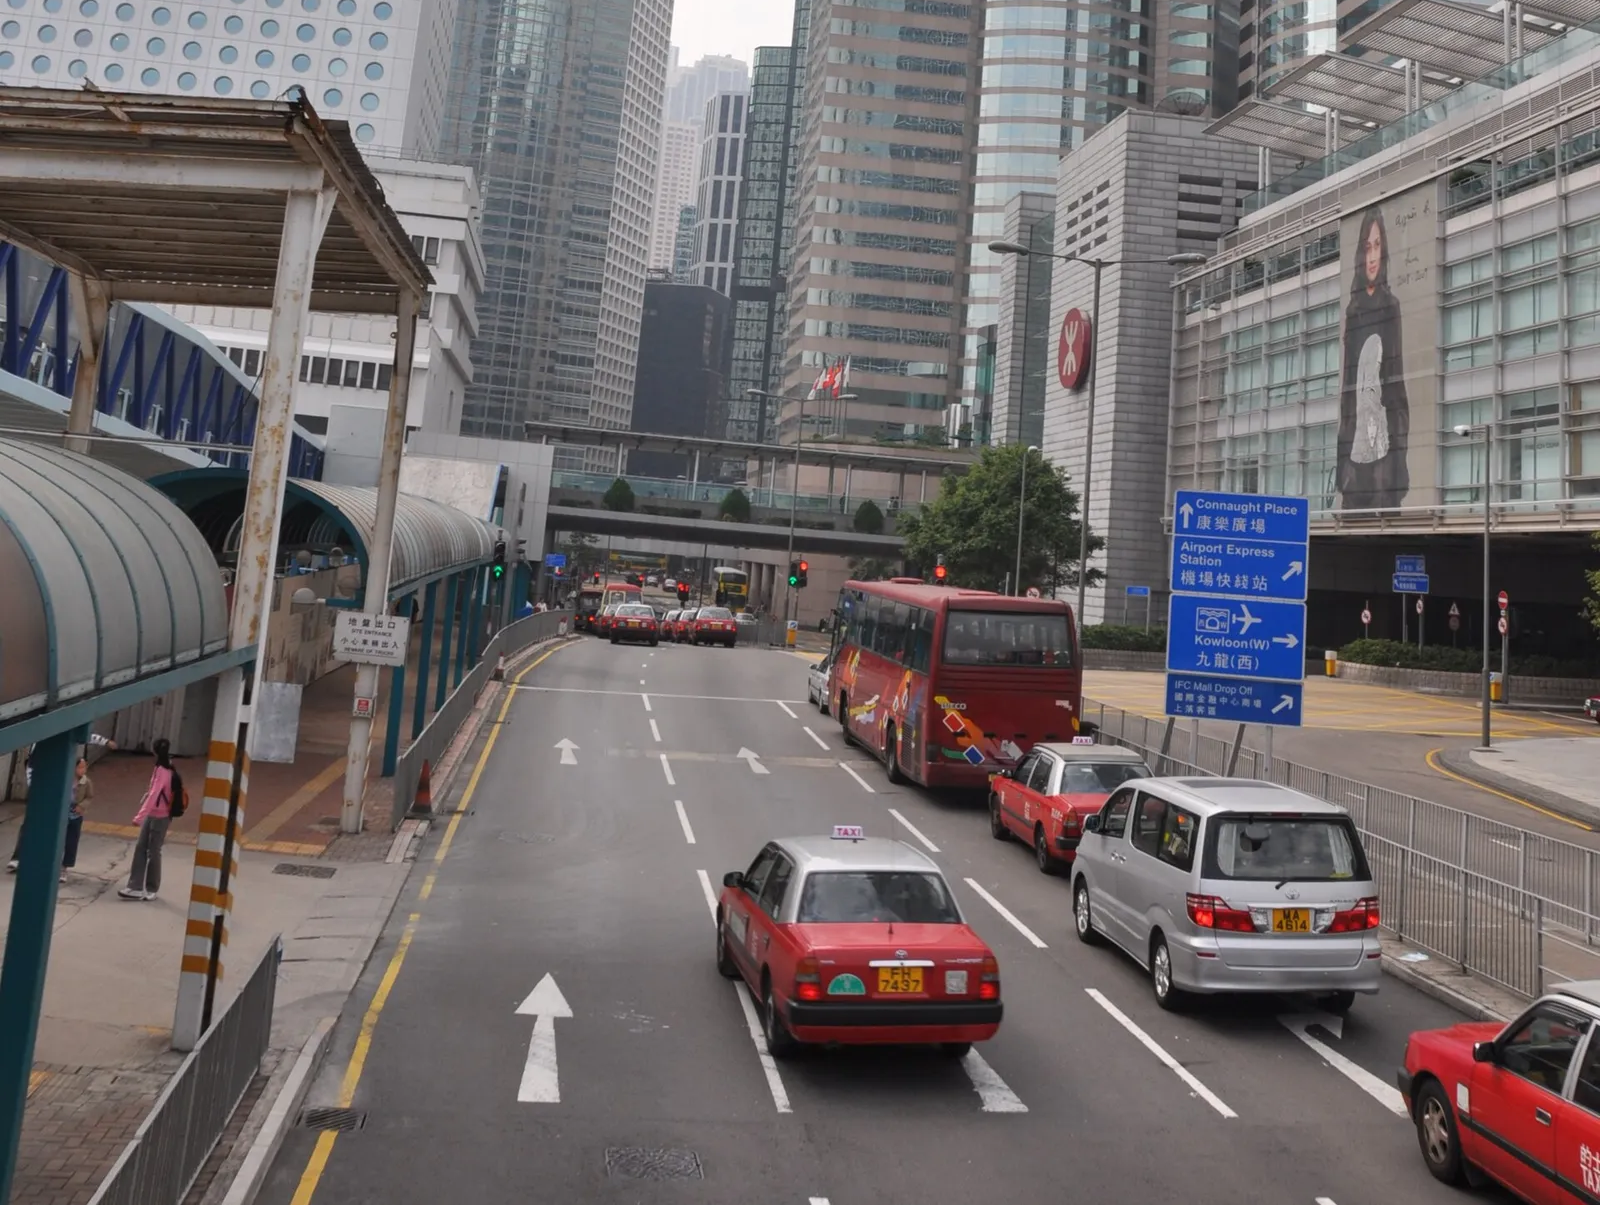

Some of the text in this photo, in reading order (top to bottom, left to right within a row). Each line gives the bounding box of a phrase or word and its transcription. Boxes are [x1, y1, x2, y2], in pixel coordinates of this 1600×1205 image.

[1196, 499, 1298, 515] Connaught Place
[1196, 515, 1266, 534] 康樂廣場
[1180, 541, 1275, 558] Airport Express
[1180, 554, 1222, 567] Station
[1180, 569, 1268, 592] 機場快綫站
[348, 617, 396, 629] 地盤出口
[364, 629, 393, 637] ENTRANCE
[1195, 635, 1270, 651] Kowloon(W)
[1195, 651, 1260, 671] 九龍(西)
[1175, 680, 1253, 696] IFC Mall Drop Off
[1075, 736, 1092, 744] TAXI
[836, 827, 861, 837] TAXI
[1283, 909, 1300, 920] MA
[1276, 920, 1307, 931] 4614
[891, 967, 911, 980] FH
[881, 980, 921, 991] 7437
